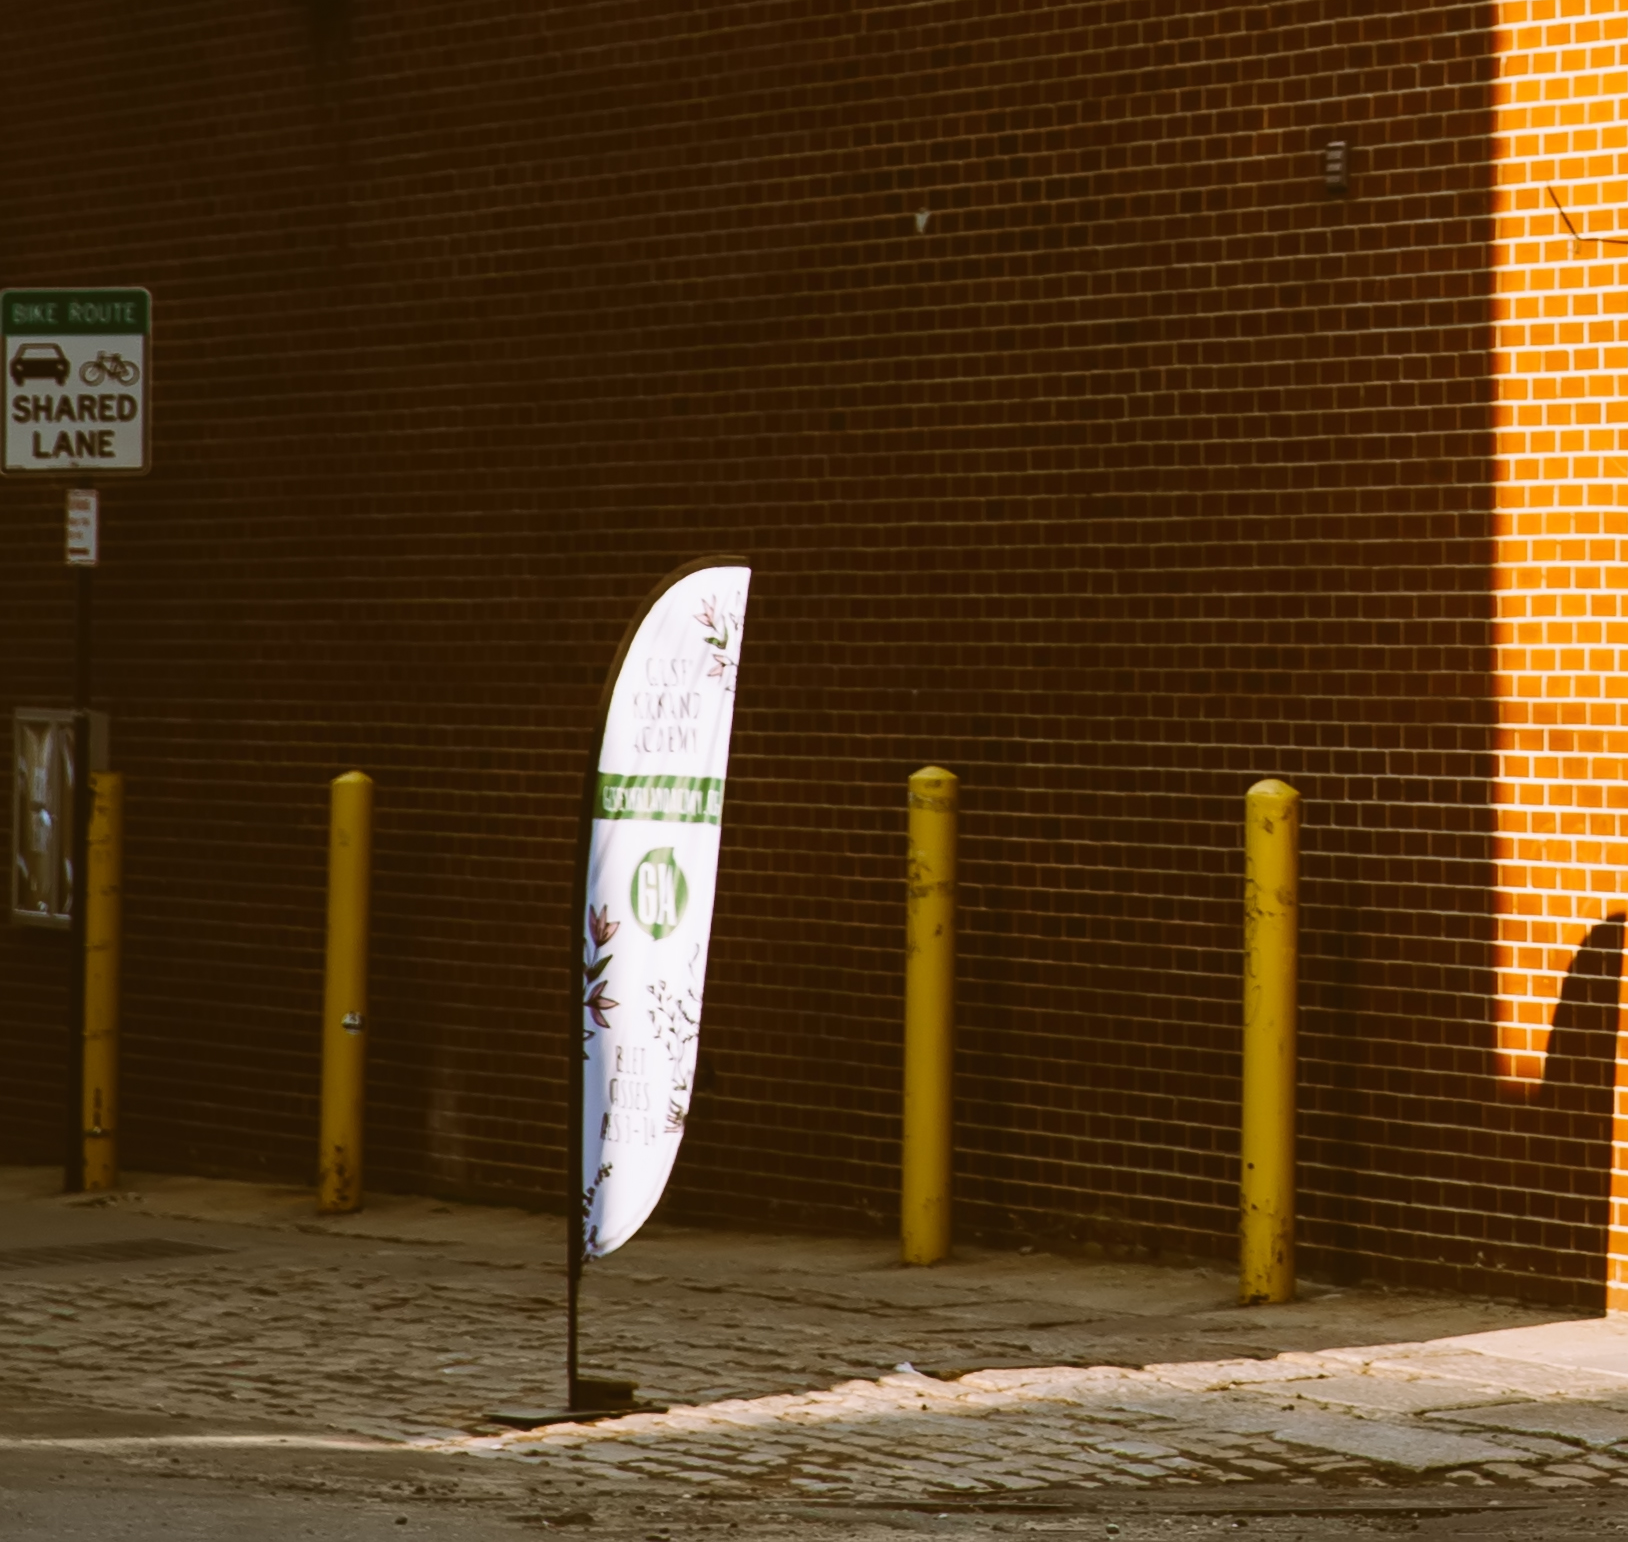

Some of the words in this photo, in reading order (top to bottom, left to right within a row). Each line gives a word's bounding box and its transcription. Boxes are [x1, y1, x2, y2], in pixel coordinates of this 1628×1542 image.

[11, 302, 59, 326] BIKE
[68, 301, 138, 325] ROUTE
[11, 393, 138, 424] SHARED
[31, 429, 117, 459] LANE
